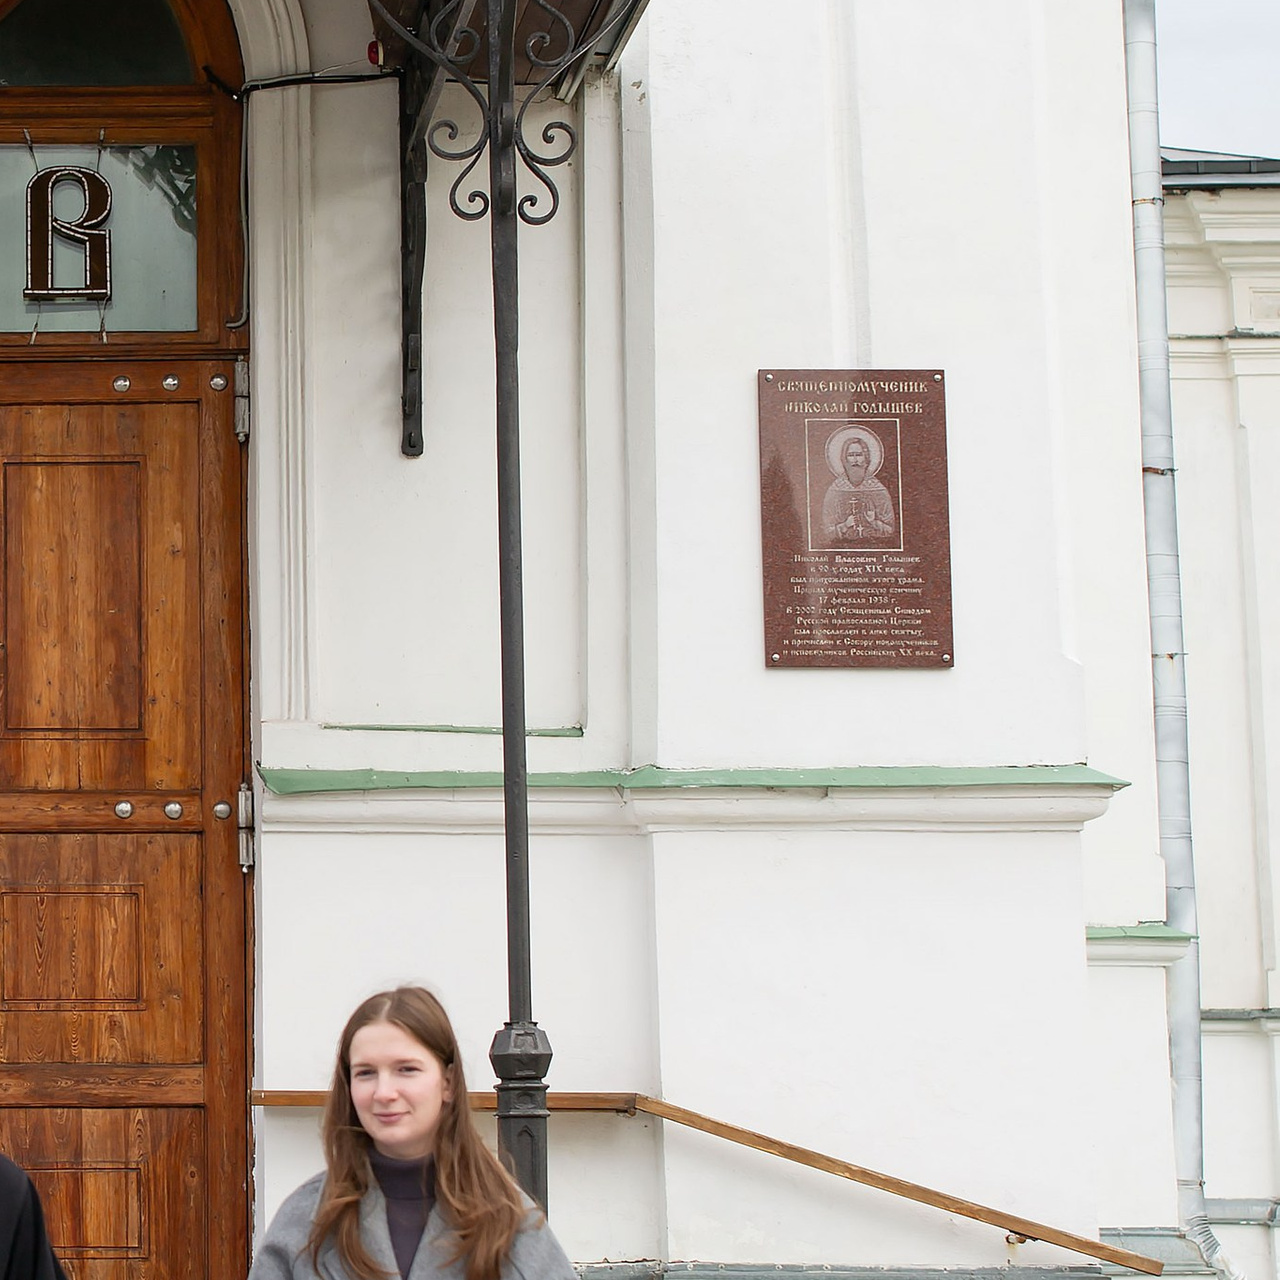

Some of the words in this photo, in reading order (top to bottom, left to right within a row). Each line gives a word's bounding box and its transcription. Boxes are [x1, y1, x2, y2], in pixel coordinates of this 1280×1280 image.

[777, 381, 928, 395] СВЯЩЕННОМУЧЕНИК
[784, 400, 848, 413] НИКОЛАЙ
[853, 402, 923, 414] ГОЛЫШЕВ
[835, 555, 877, 563] Власович
